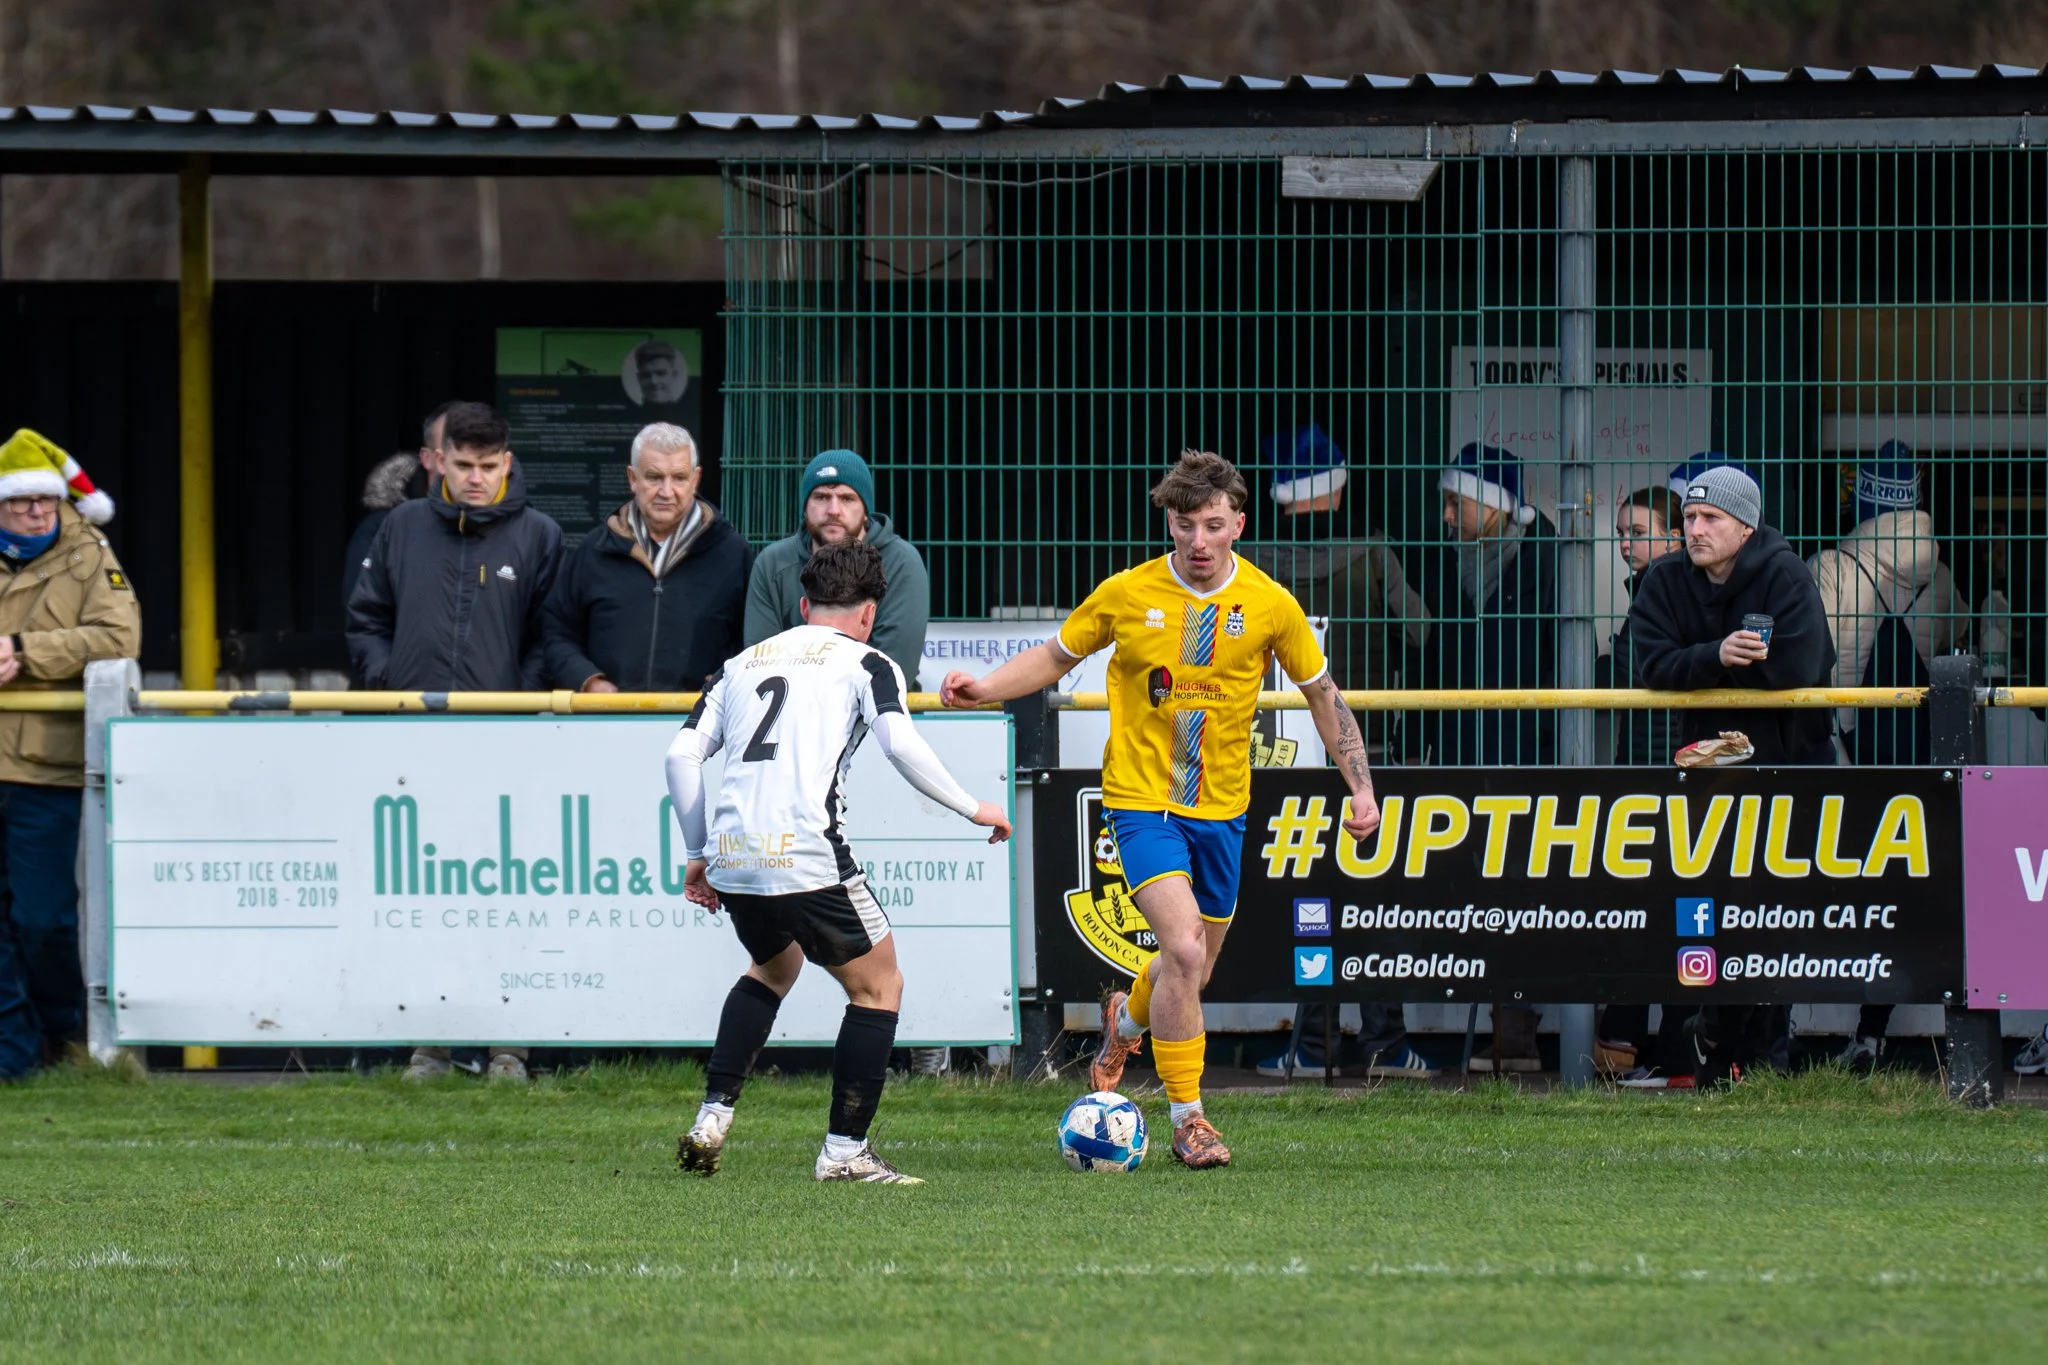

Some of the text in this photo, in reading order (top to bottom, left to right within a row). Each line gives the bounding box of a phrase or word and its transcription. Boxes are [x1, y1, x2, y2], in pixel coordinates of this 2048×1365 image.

[1595, 362, 1688, 388] PECIALS
[1174, 692, 1228, 701] HOSPITALITY
[1175, 682, 1221, 693] HUGHES
[742, 675, 789, 762] 2
[1261, 794, 1931, 879] #UPTHEVILLA
[154, 861, 339, 883] UK'S BEST ICE CREAM
[715, 857, 794, 870] COMPETITIONS
[884, 861, 958, 881] FACTORY
[966, 861, 985, 881] AT
[236, 886, 278, 908] 2018
[297, 886, 339, 908] 2019
[374, 908, 725, 929] ICE CREAM PARLOURS
[1341, 904, 1647, 934] Boldoncafc@yahoo.com
[1721, 904, 1816, 930] Boldon
[1822, 904, 1857, 930] CA
[1863, 904, 1898, 930] FC
[1082, 912, 1120, 954] BOLDON
[1340, 953, 1486, 981] @CaBoldon
[1722, 953, 1893, 983] @Boldoncafc
[500, 971, 605, 990] SINCE 1942
